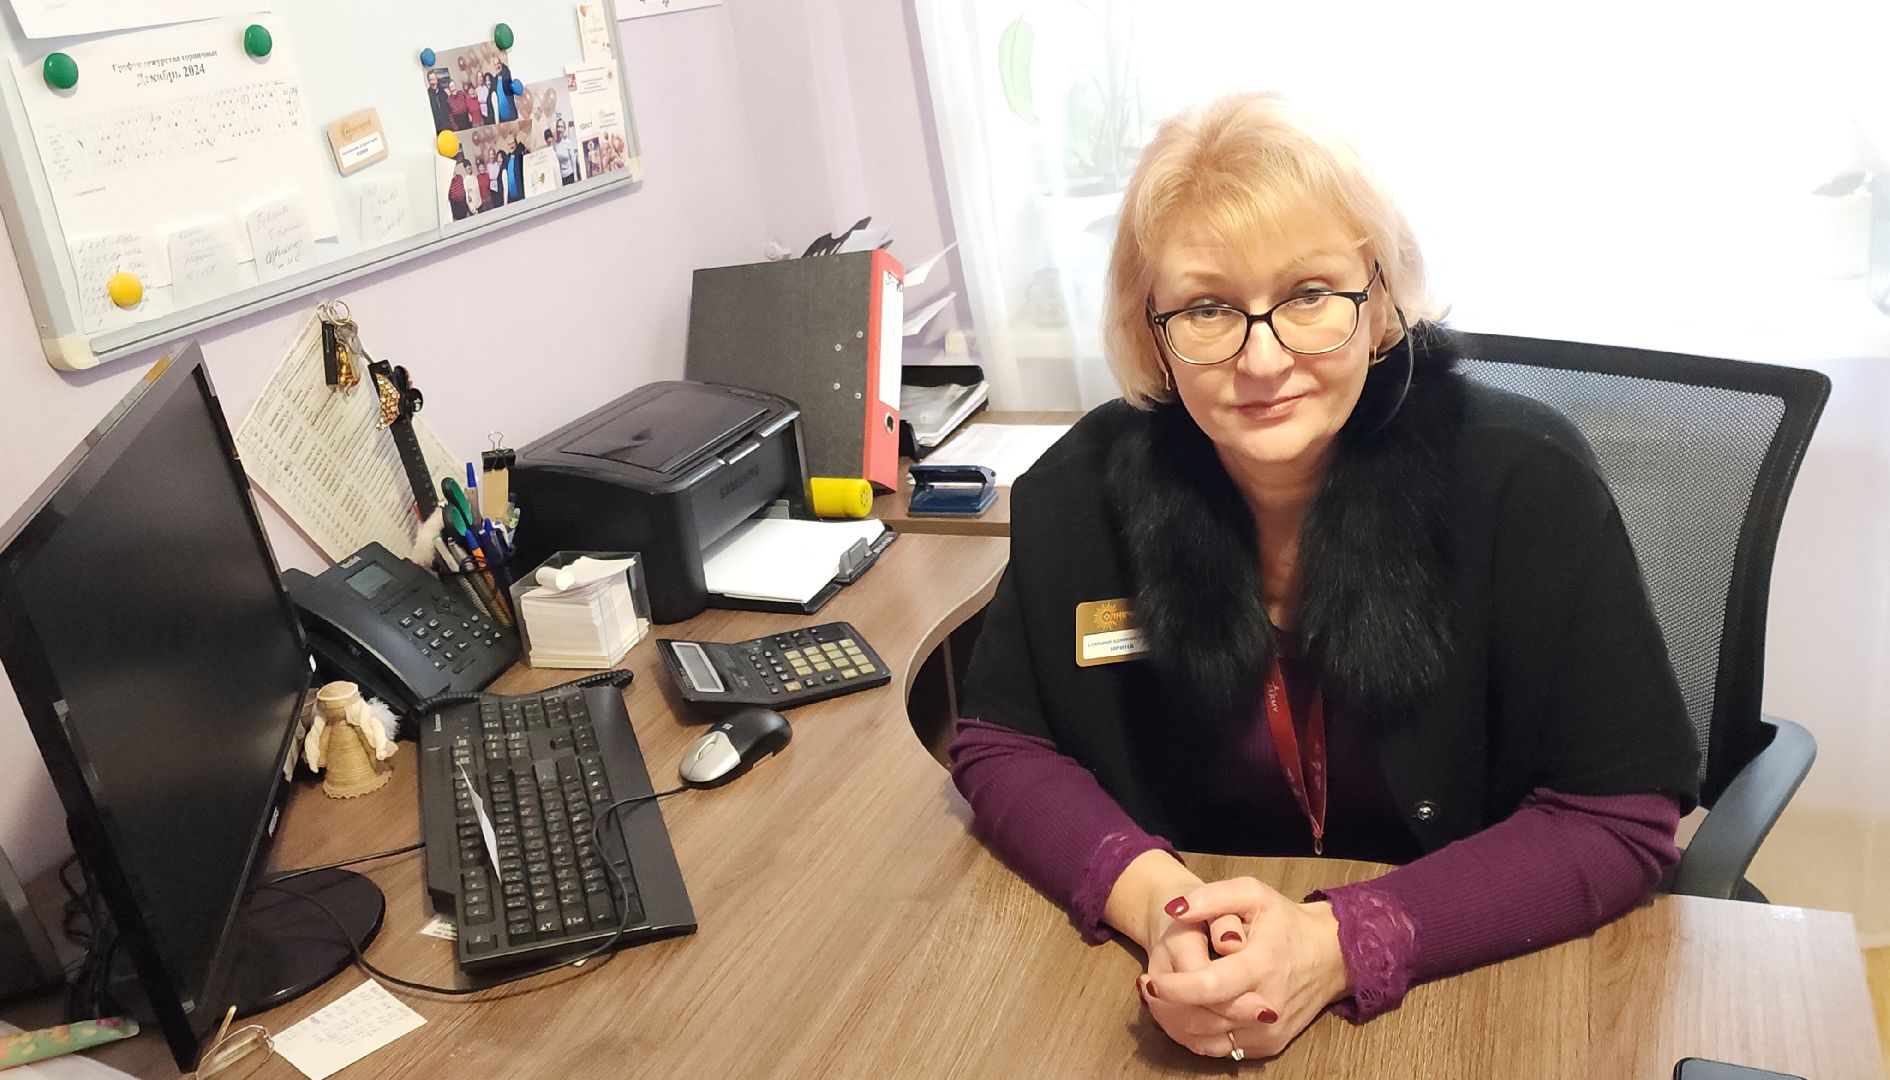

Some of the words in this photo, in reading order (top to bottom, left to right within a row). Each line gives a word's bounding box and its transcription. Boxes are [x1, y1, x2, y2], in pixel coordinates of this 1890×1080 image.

[136, 70, 182, 87] Декабрь
[183, 63, 206, 78] 2024
[719, 464, 760, 500] SAMSUNG
[1110, 643, 1135, 653] ИРИНА
